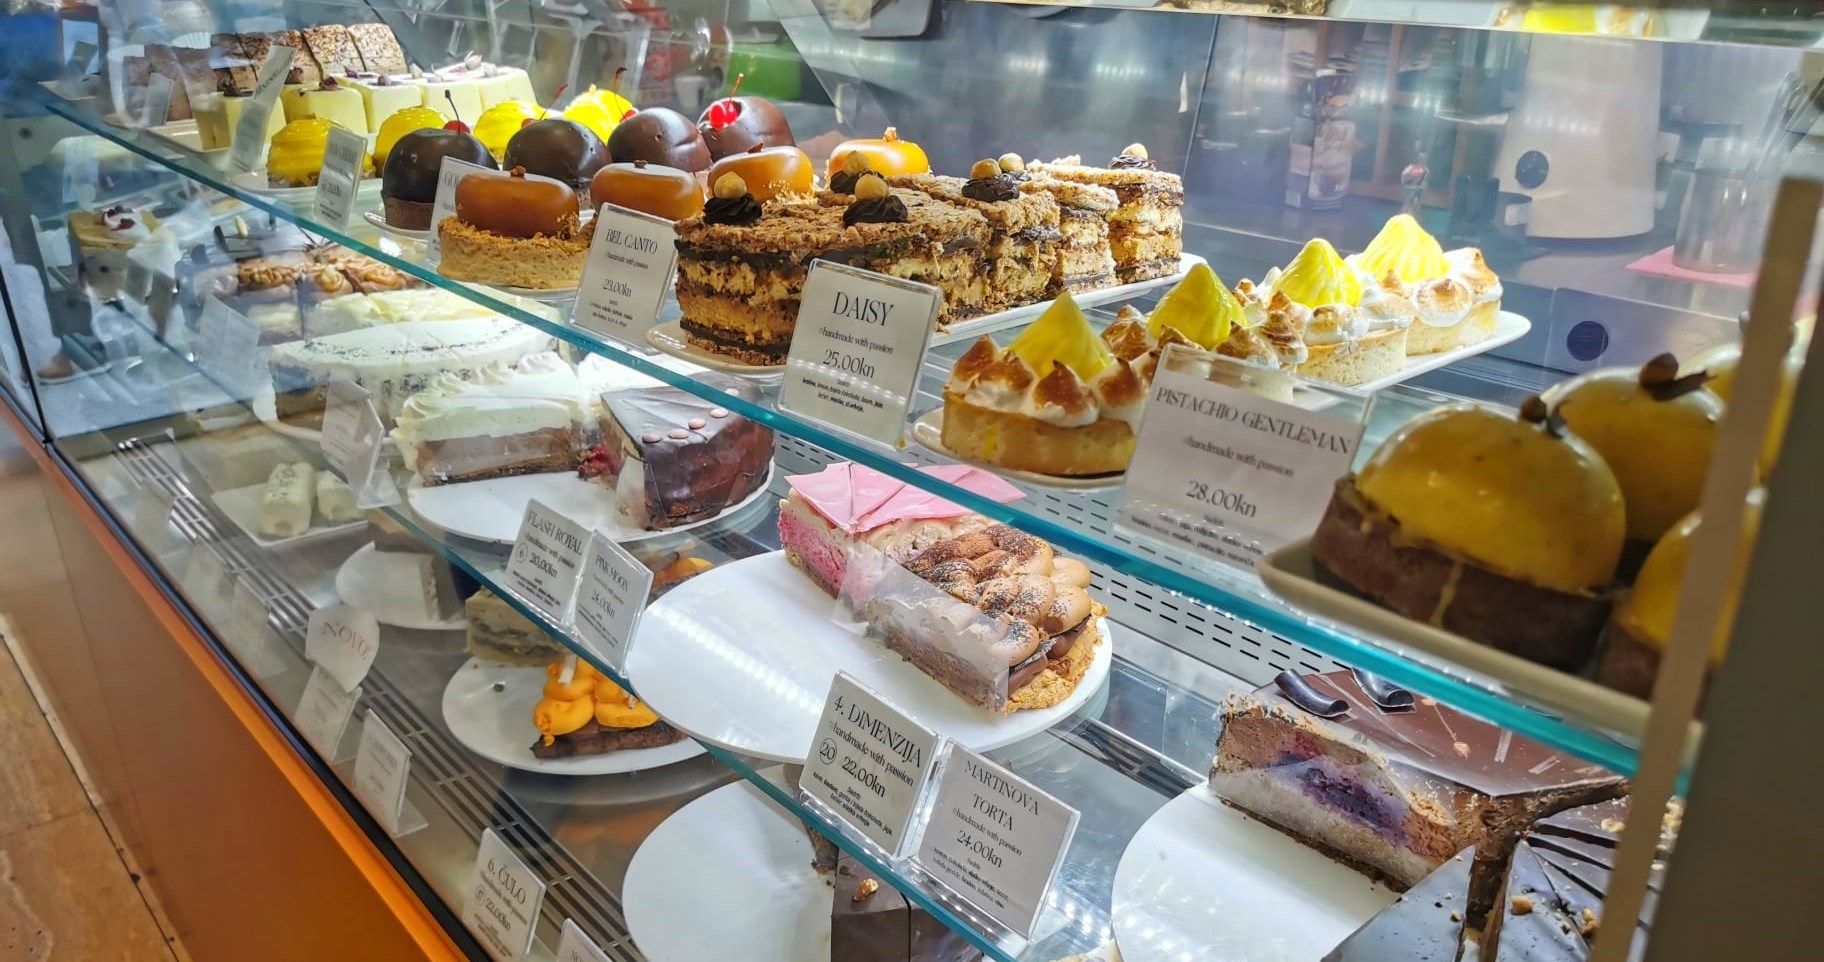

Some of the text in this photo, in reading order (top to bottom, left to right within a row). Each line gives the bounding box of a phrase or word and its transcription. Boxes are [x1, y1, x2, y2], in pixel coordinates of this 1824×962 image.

[606, 228, 658, 255] BEL CANTO
[832, 291, 895, 327] DAISY
[822, 349, 875, 379] 25.00kn
[854, 336, 869, 349] with
[868, 341, 894, 355] passion
[1155, 386, 1351, 455] PISTACHIO GENTLEMAN
[1236, 451, 1256, 469] with
[1185, 480, 1257, 519] 28.00kn
[527, 510, 583, 556] FLASH ROYAL
[833, 695, 922, 769] 4. DIMENZIJA
[819, 741, 887, 799] 20 22.00kn
[870, 749, 886, 767] with
[885, 761, 914, 788] passion
[964, 760, 1040, 816] MARTINOVA
[972, 793, 1014, 831] TORTA
[956, 829, 1003, 869] 24.00kn
[986, 827, 999, 842] with
[998, 836, 1023, 857] passion
[487, 858, 496, 875] 6.
[499, 863, 526, 905] ČULO
